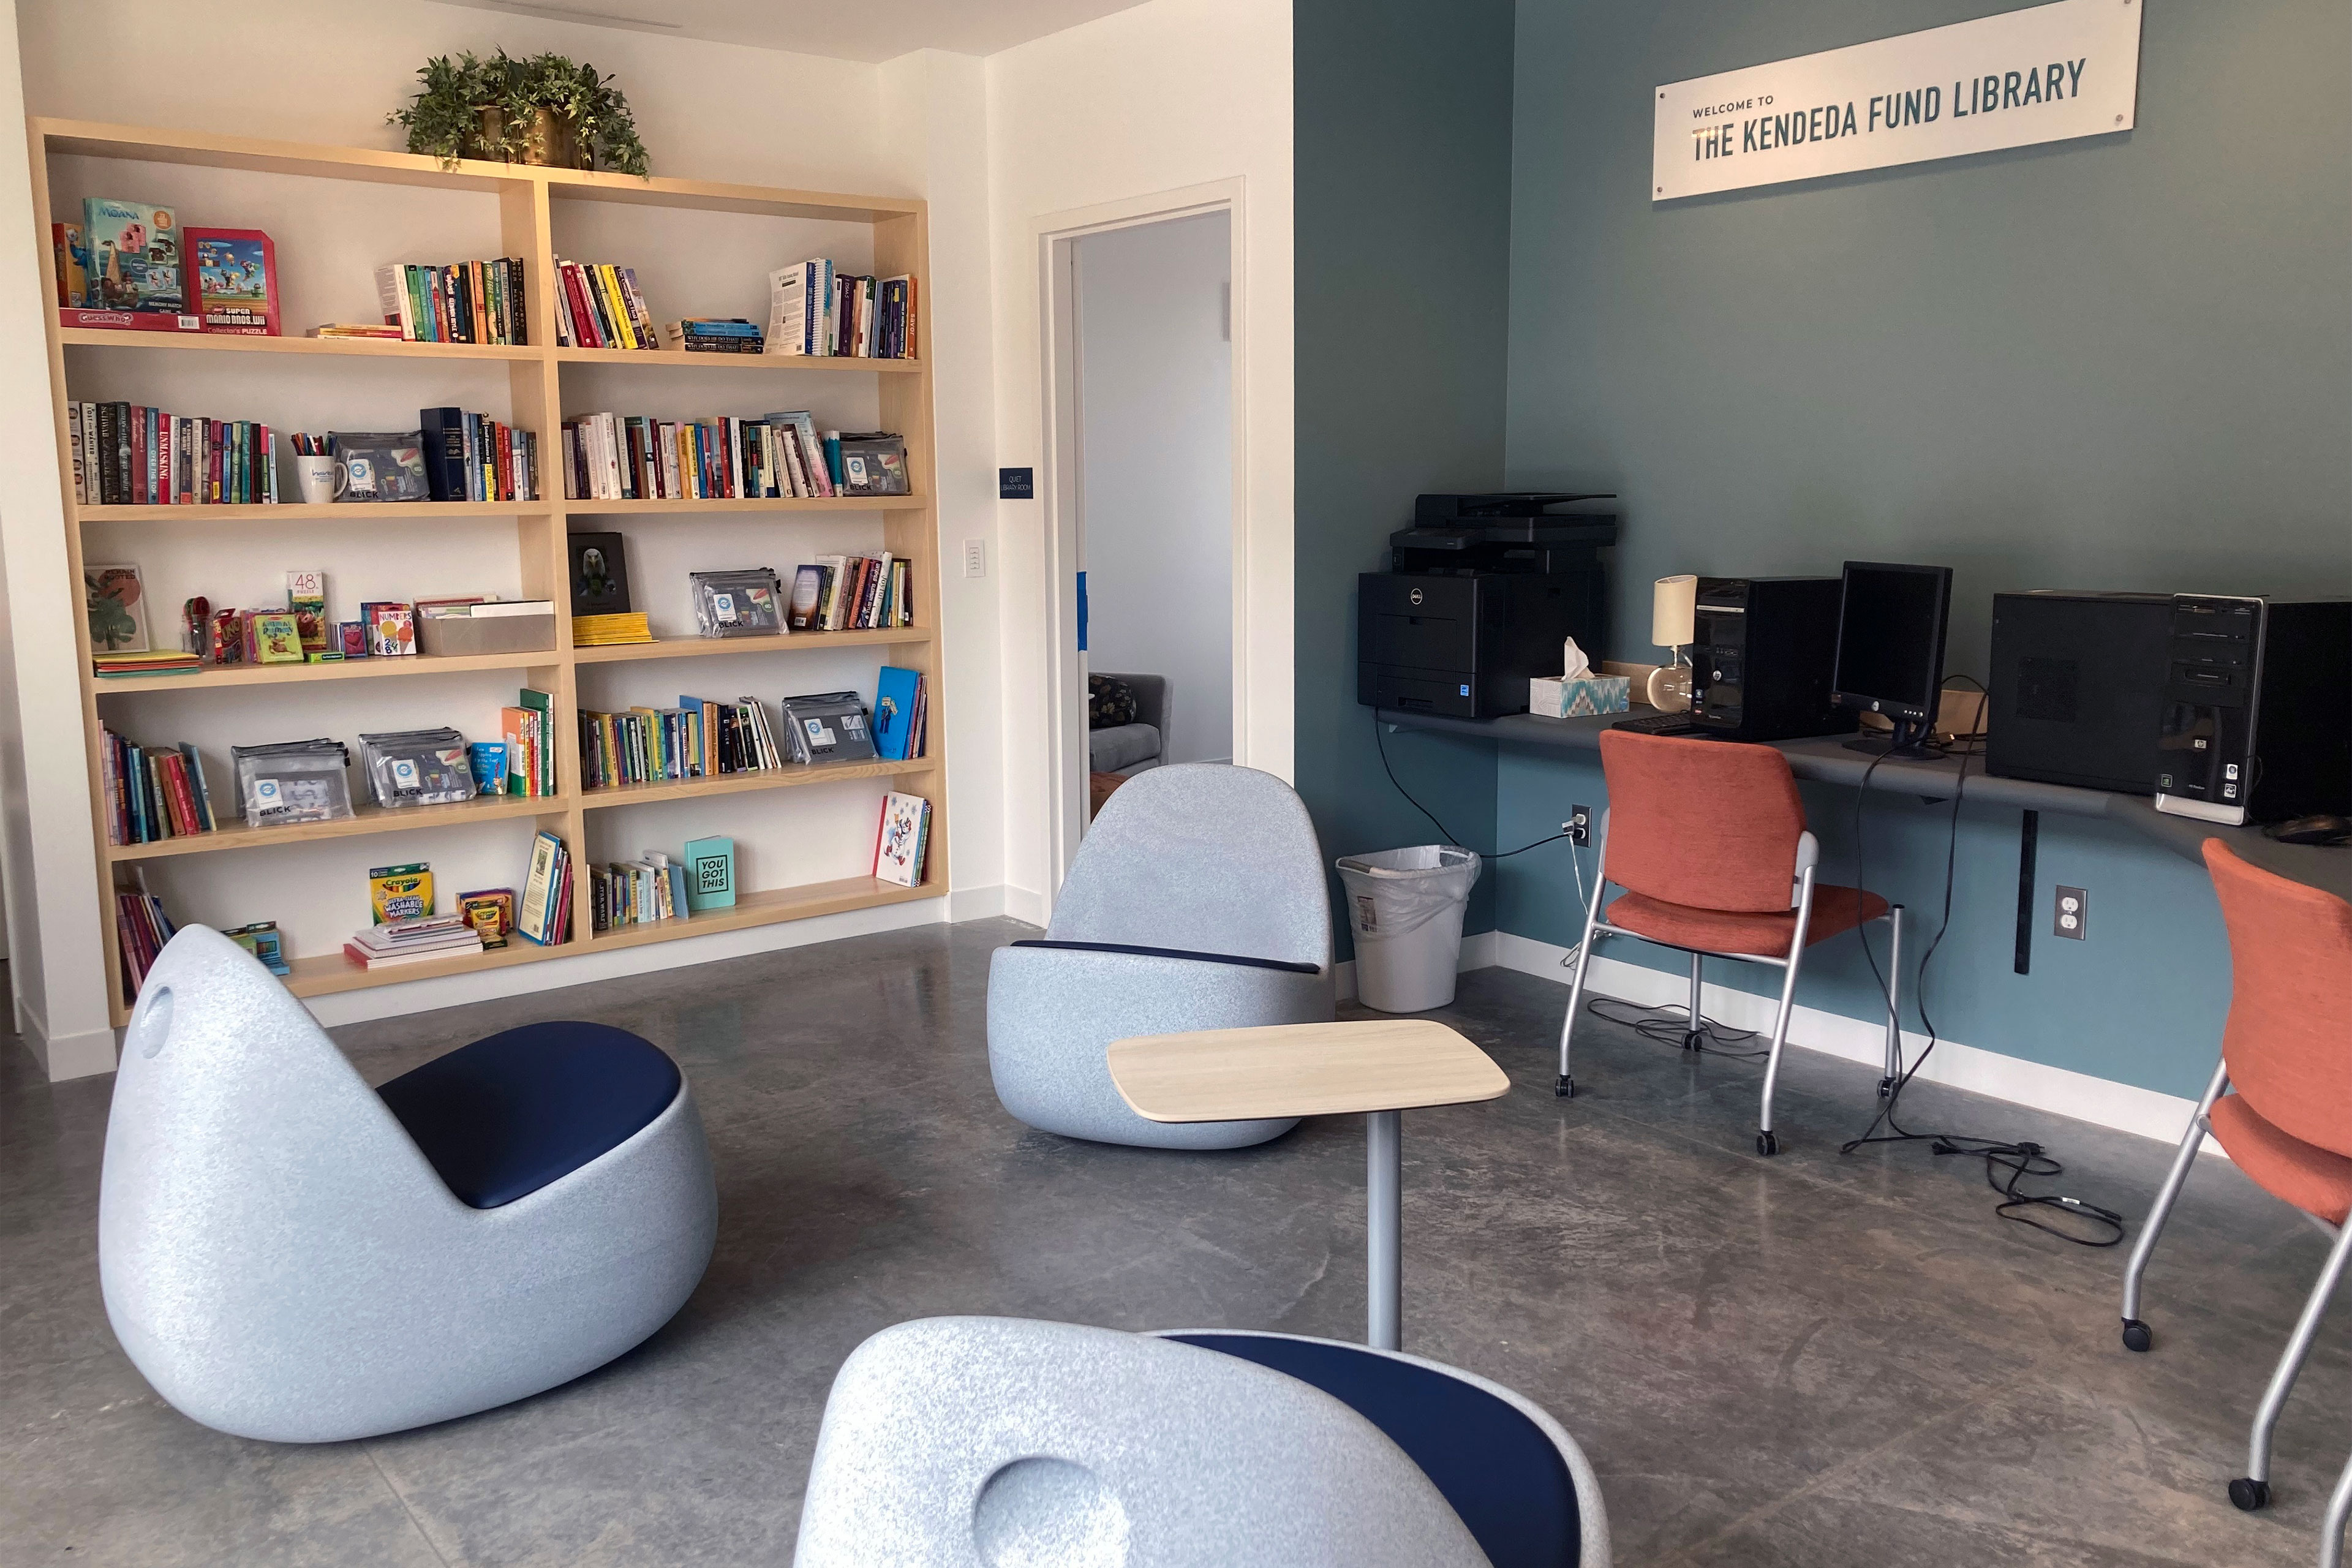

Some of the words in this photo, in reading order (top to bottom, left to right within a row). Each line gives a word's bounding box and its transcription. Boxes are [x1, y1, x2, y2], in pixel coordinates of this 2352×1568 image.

[1691, 124, 1733, 161] THE
[1743, 102, 1857, 153] KENDEDA
[1869, 86, 1940, 133] FUND
[1953, 58, 2087, 119] LIBRARY
[1693, 98, 1753, 119] WELCOME
[1758, 96, 1774, 106] TO
[99, 207, 140, 220] MOANA
[206, 314, 230, 324] MARIO
[100, 407, 110, 438] SCHWAB
[159, 431, 169, 480] UNMASKING
[295, 574, 315, 590] 48
[877, 575, 888, 600] Joyful
[379, 612, 412, 621] NUMBERS
[221, 618, 241, 641] UNO
[385, 646, 392, 654] 8
[391, 641, 398, 650] 4
[393, 788, 423, 797] BLICK
[260, 805, 292, 816] BLICK
[701, 859, 724, 870] YOU
[701, 869, 725, 880] GOT
[386, 877, 418, 886] Crayola
[701, 878, 725, 889] THIS
[388, 895, 420, 905] ULTRA-CLEAN
[384, 900, 423, 912] WASHABLE
[390, 908, 420, 918] MARKERS
